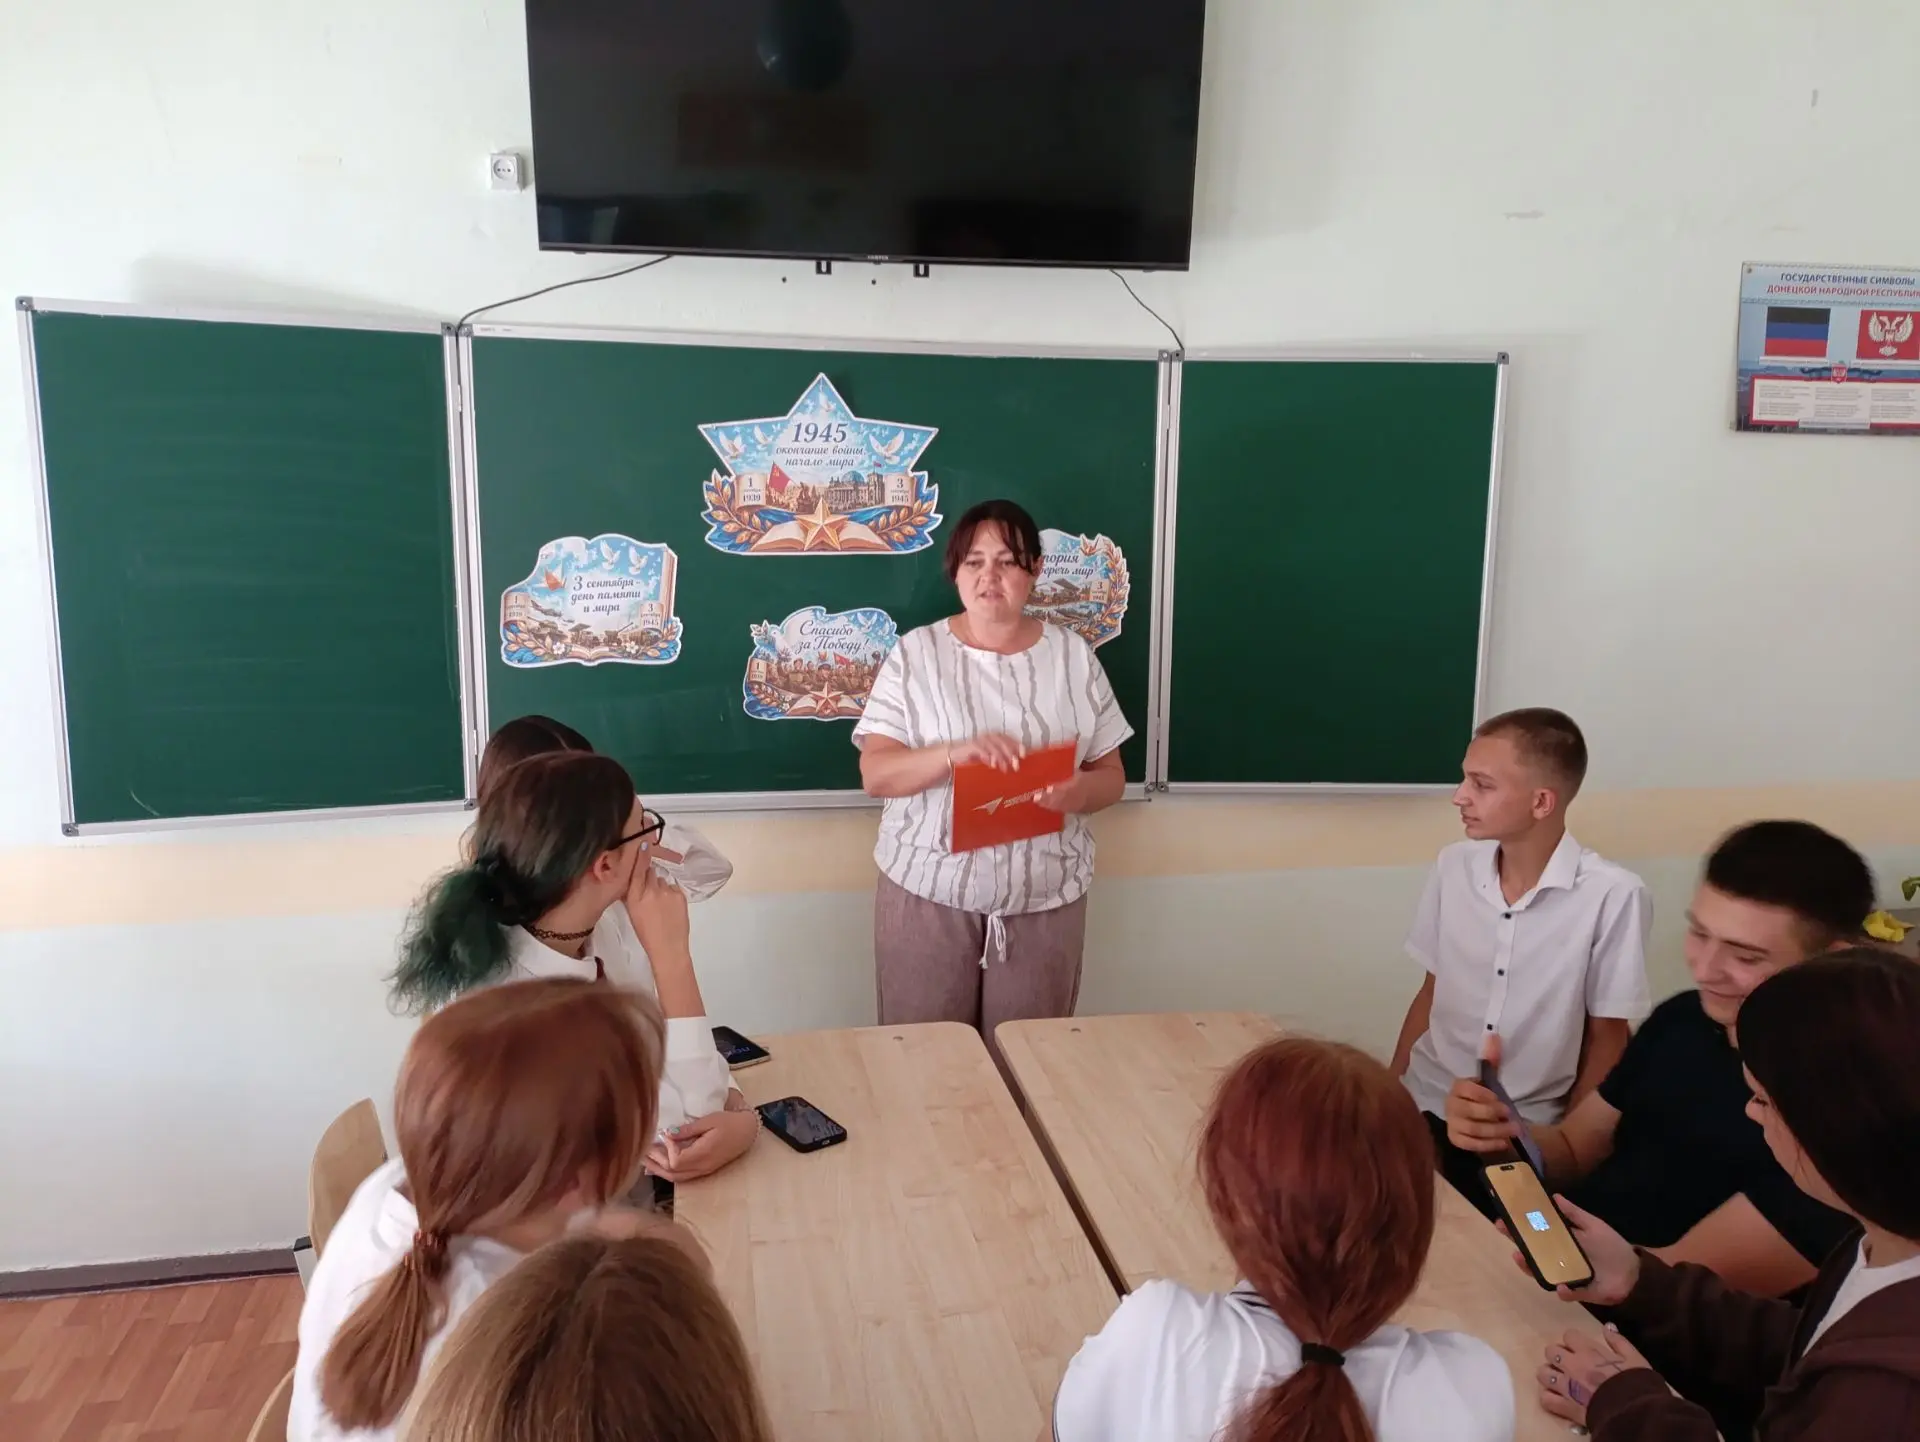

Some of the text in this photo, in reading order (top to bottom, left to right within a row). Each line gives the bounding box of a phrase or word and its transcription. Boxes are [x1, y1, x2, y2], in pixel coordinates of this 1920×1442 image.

[1780, 272, 1916, 286] ГОСУДАРСТВЕННЫЕ СИМВОЛЫ
[1766, 284, 1817, 295] ДОНЕЦКОЙ
[1819, 287, 1869, 297] НАРОДНОЙ
[792, 422, 848, 443] 1945
[776, 446, 828, 455] окончание
[785, 458, 854, 469] начало мира
[896, 478, 904, 488] 3
[1071, 567, 1094, 579] мир
[573, 575, 583, 591] 3
[586, 577, 634, 590] сентября
[571, 591, 641, 606] день памяти
[583, 604, 620, 616] и мира
[800, 619, 853, 636] Спасибо
[795, 635, 870, 656] за Победу!
